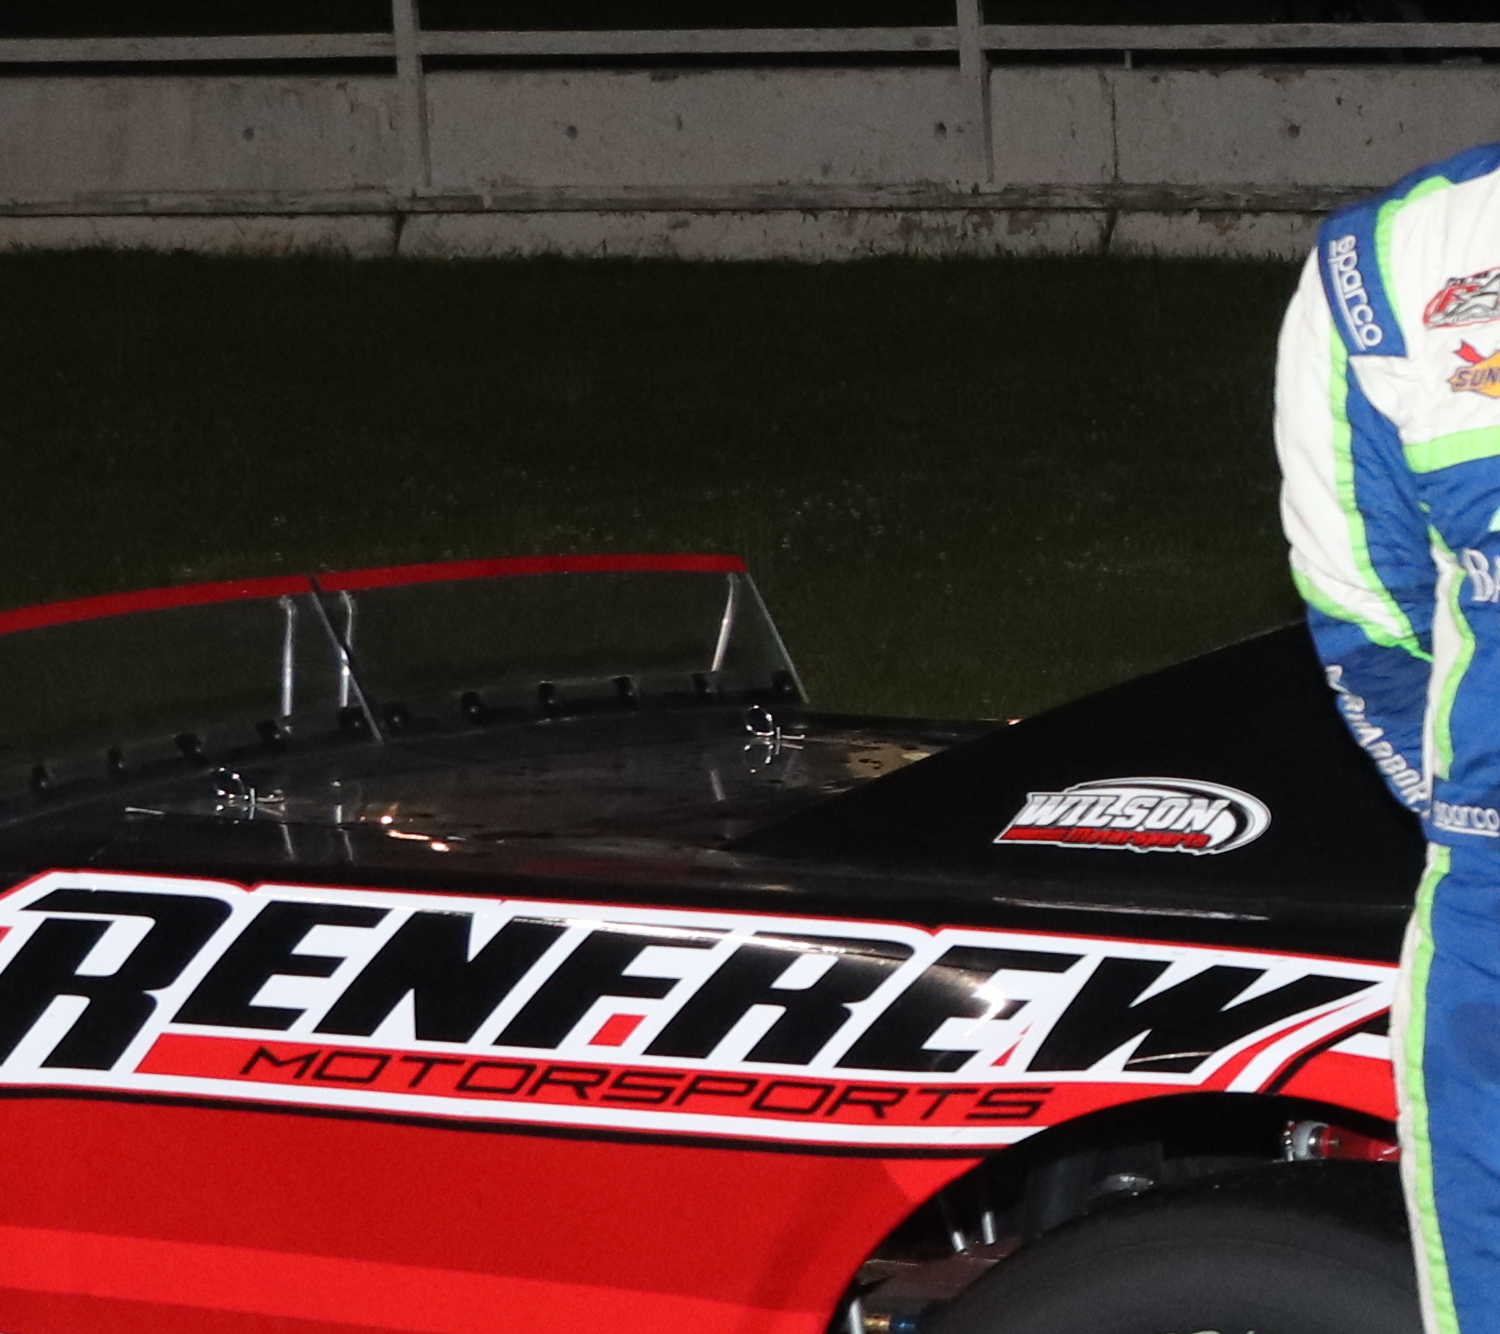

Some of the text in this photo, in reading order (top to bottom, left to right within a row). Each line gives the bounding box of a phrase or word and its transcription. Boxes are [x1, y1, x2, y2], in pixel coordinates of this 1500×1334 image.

[1329, 234, 1384, 351] sparco
[1013, 793, 1231, 833] WILSON
[0, 881, 1395, 1079] RENFREW
[243, 1043, 1049, 1124] MOTORSPORTS
